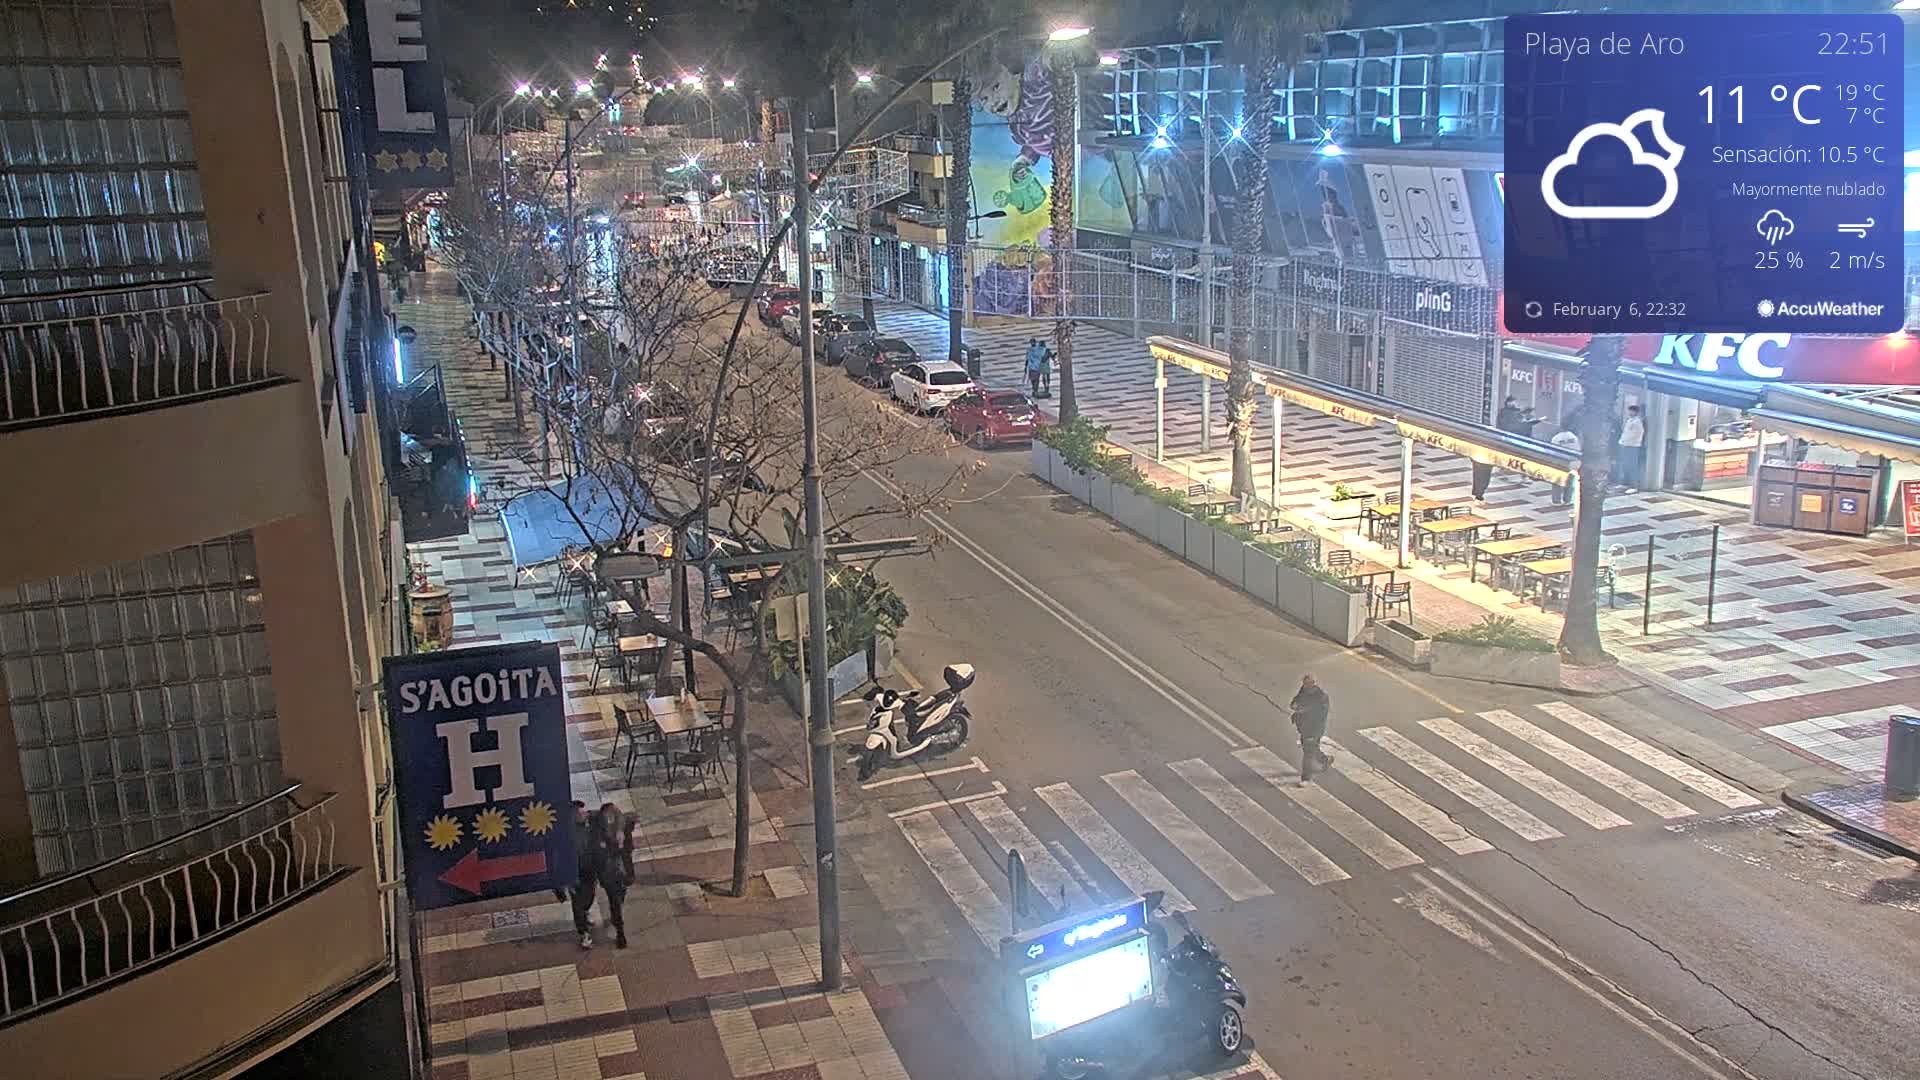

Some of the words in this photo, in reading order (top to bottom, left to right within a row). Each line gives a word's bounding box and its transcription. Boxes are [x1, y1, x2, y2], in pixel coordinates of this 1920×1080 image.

[1654, 333, 1791, 378] KFC
[1512, 369, 1533, 384] KFC
[1331, 405, 1345, 417] KFC
[1427, 433, 1444, 447] KFC
[1508, 457, 1527, 472] KFC
[435, 712, 536, 810] H
